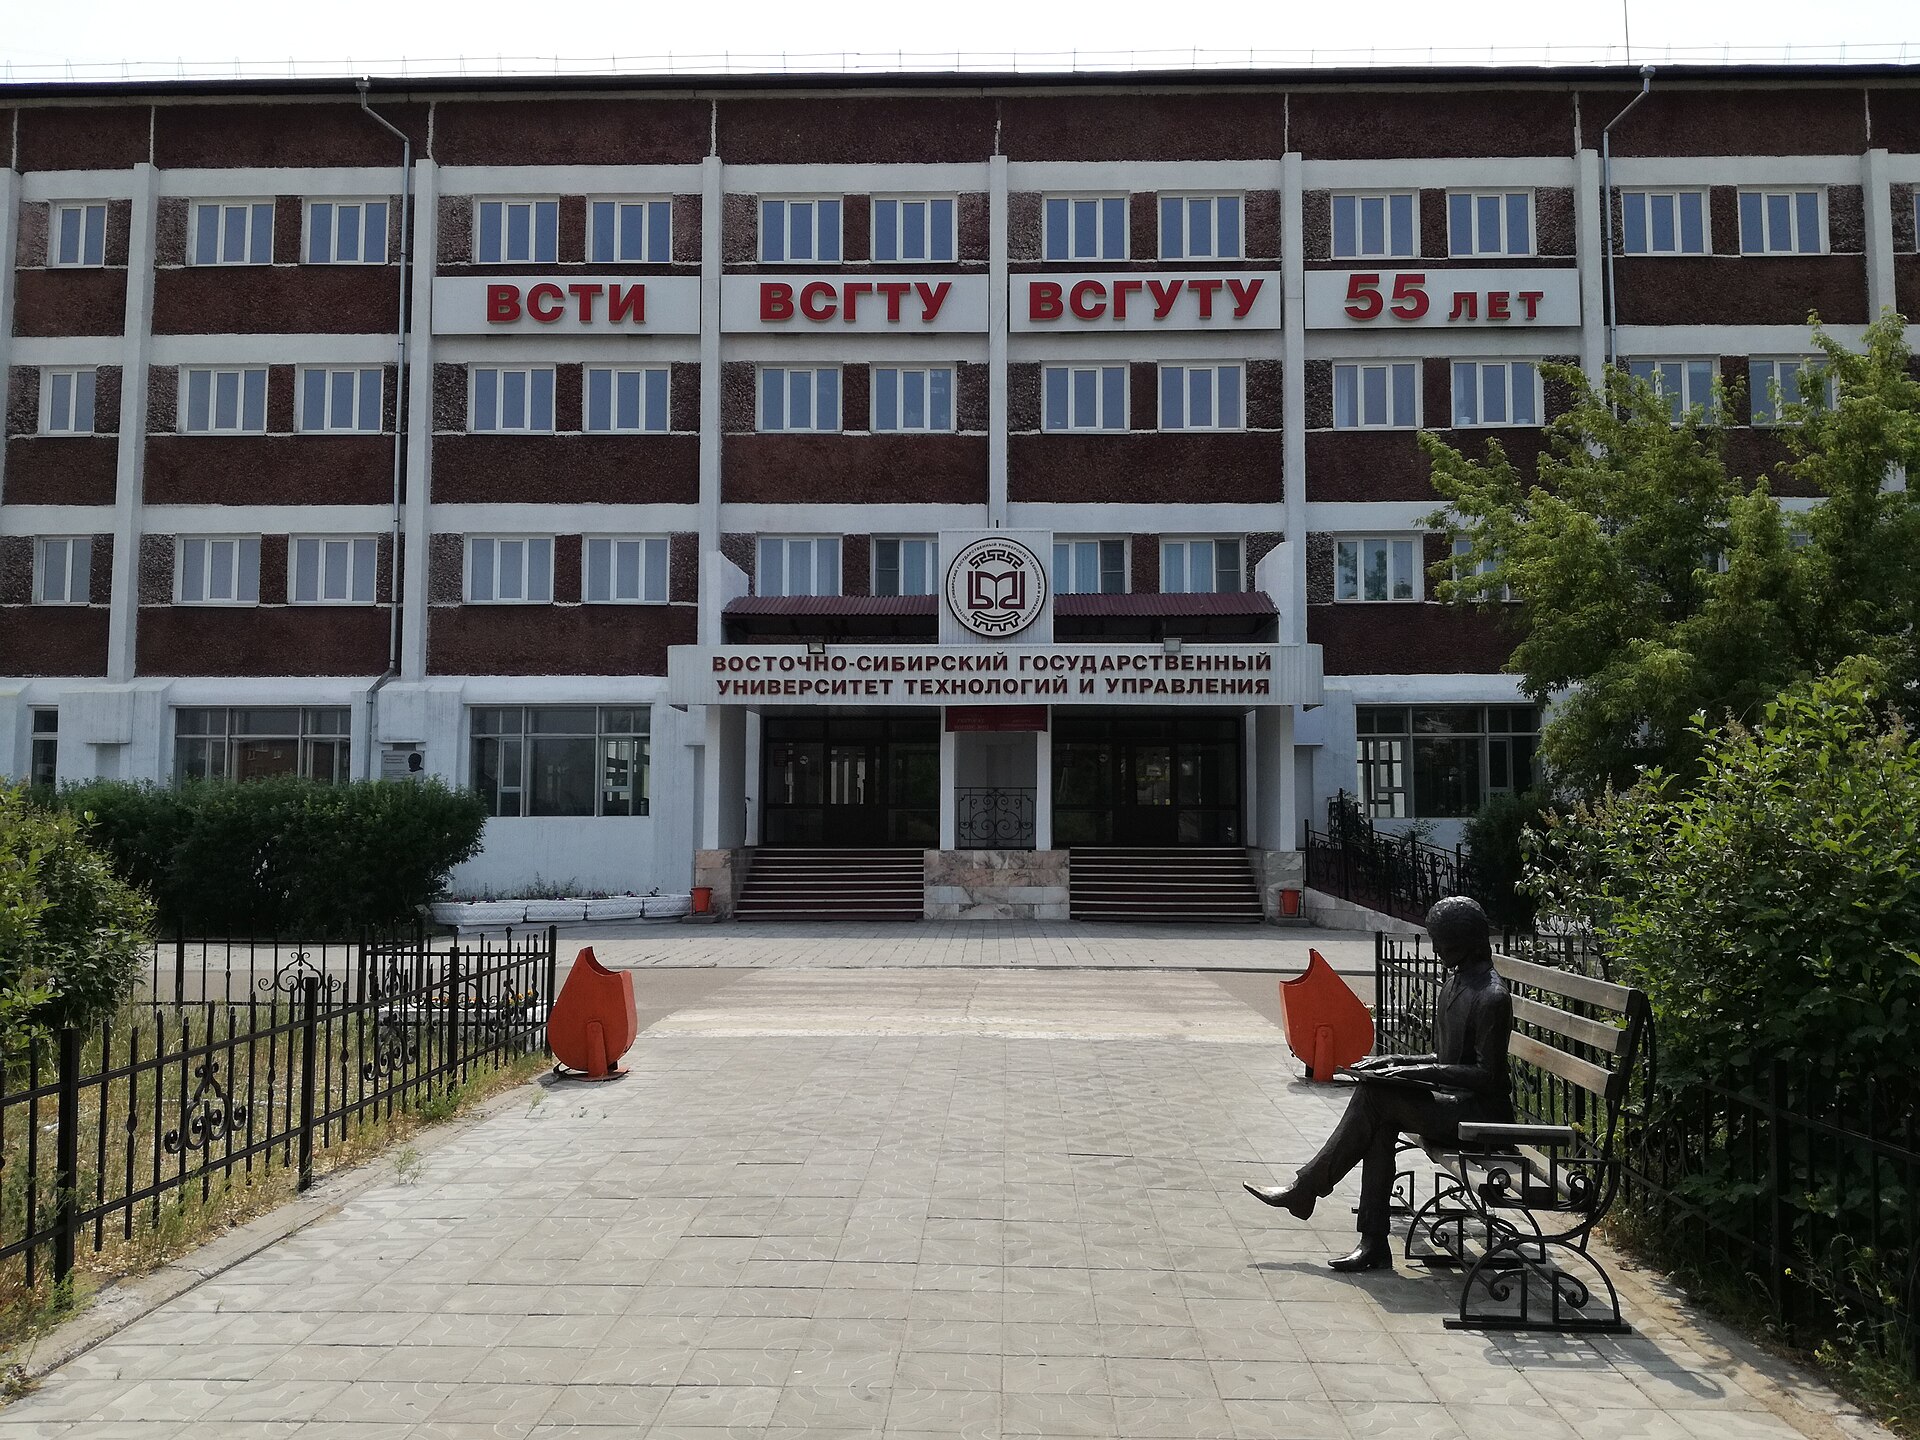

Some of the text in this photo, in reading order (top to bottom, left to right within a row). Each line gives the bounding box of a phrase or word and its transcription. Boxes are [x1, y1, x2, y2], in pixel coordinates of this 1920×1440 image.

[486, 282, 647, 324] ВСТИ
[759, 281, 953, 322] ВСГТУ
[1028, 279, 1265, 322] ВСГУТУ
[1344, 273, 1545, 322] 55 ЛЕТ
[712, 651, 1272, 674] ВОСТОЧНО-СИБИРСКИЙ ГОСУДАРСТВЕННЫЙ
[716, 675, 1270, 696] УНИВЕРСИТЕТ ТЕХНОЛОГИЙ И УПРАВЛЕНИЯ
